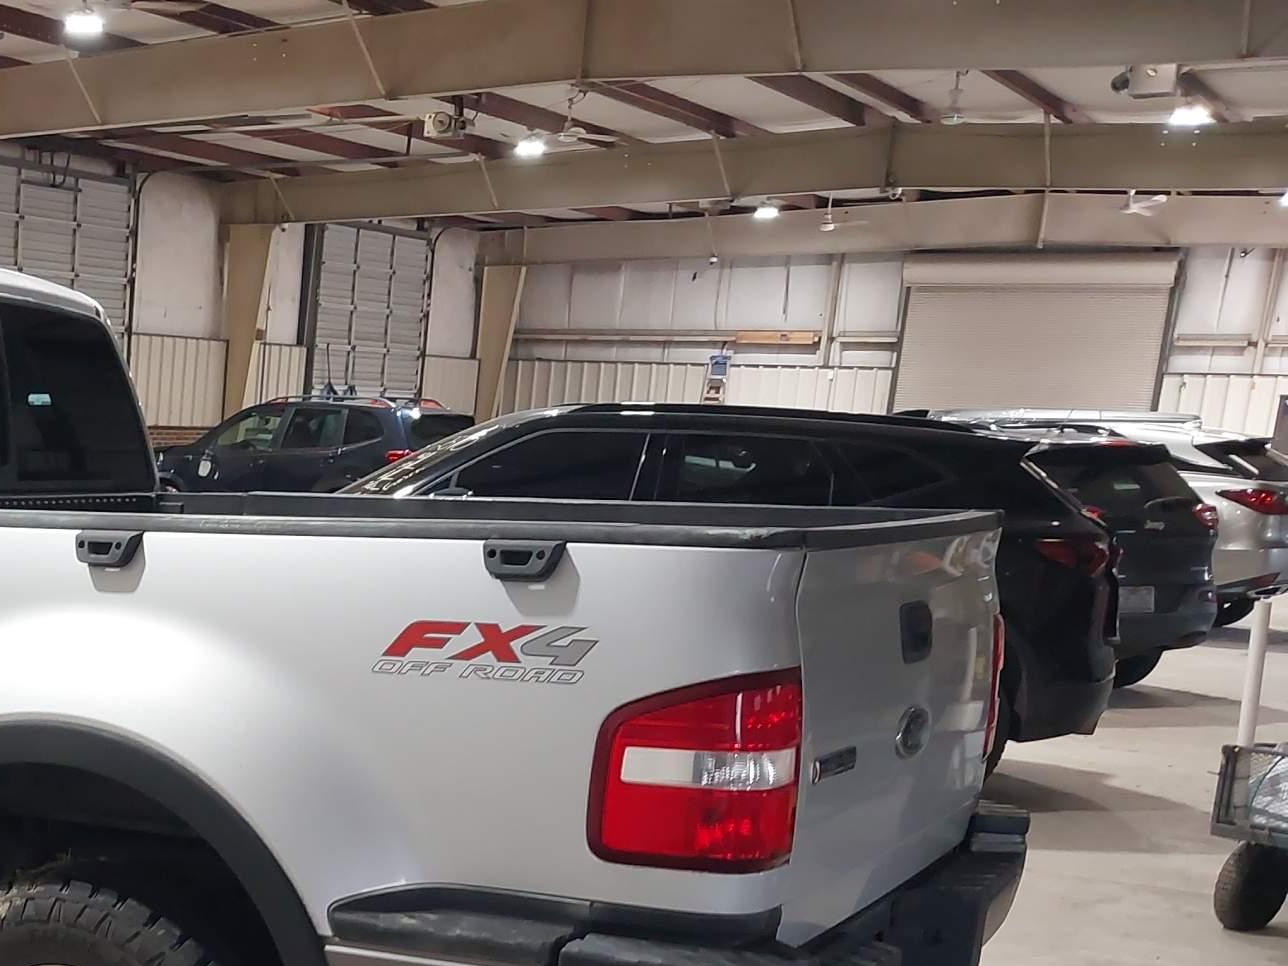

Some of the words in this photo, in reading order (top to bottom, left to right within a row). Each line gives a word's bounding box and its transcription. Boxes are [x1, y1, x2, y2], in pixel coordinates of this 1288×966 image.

[381, 620, 600, 667] FX4
[371, 659, 452, 677] OFF
[459, 663, 585, 685] ROAD
